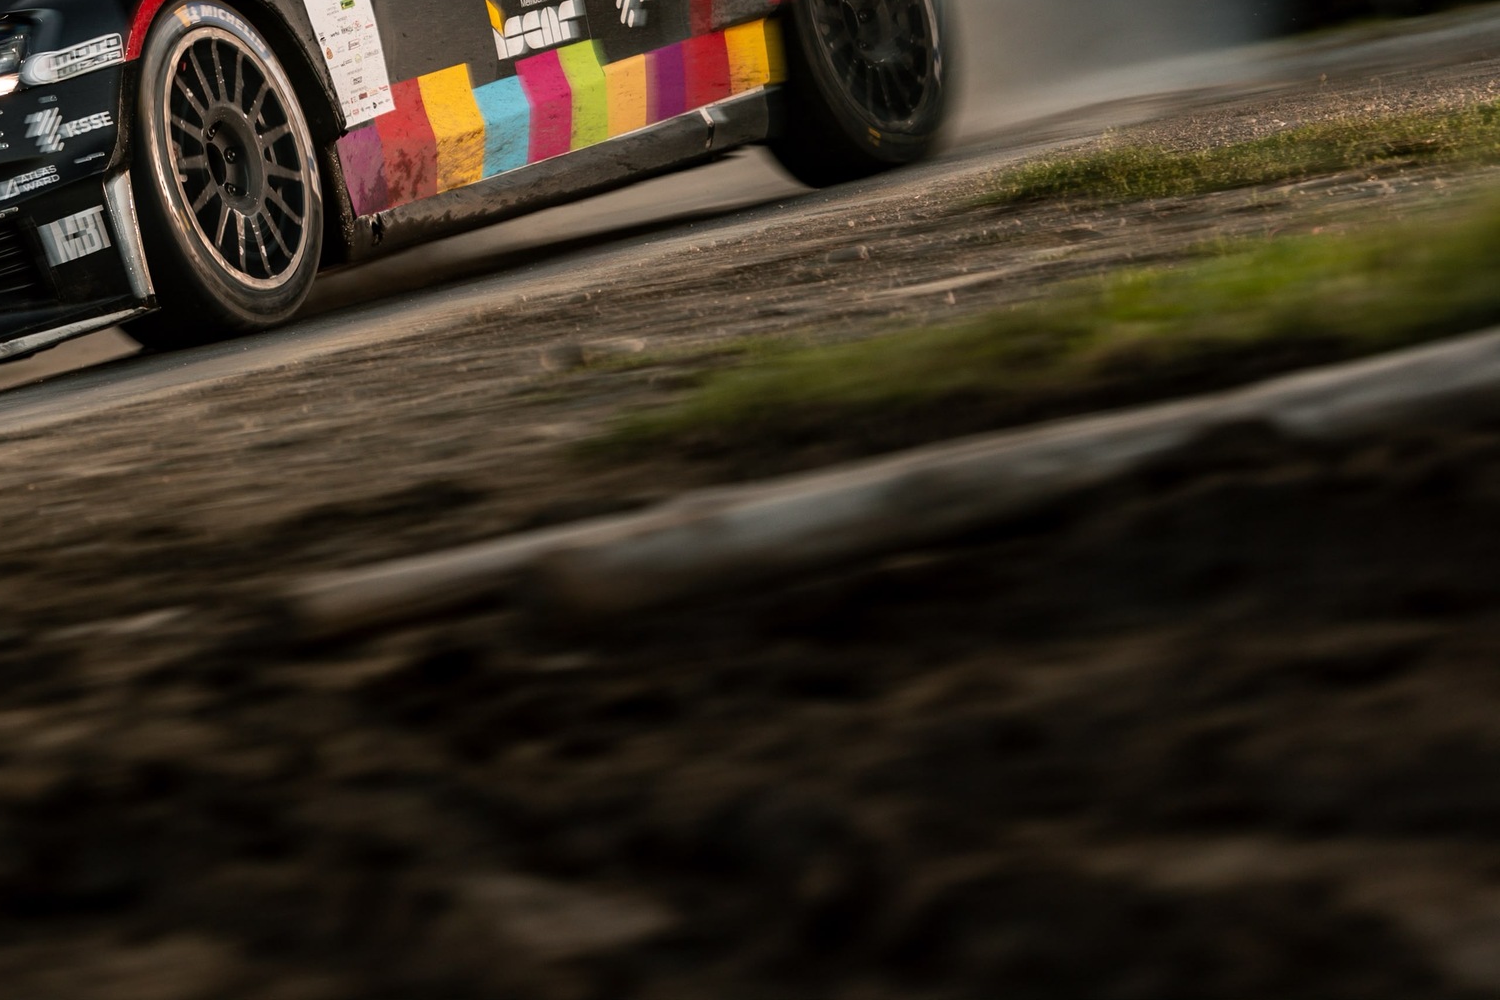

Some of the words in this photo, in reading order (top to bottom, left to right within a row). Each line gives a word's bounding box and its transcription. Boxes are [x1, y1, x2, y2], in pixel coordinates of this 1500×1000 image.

[199, 4, 267, 54] MICHELIN
[65, 110, 114, 138] KSSE
[20, 164, 58, 183] ATLAS
[21, 173, 61, 193] WARD
